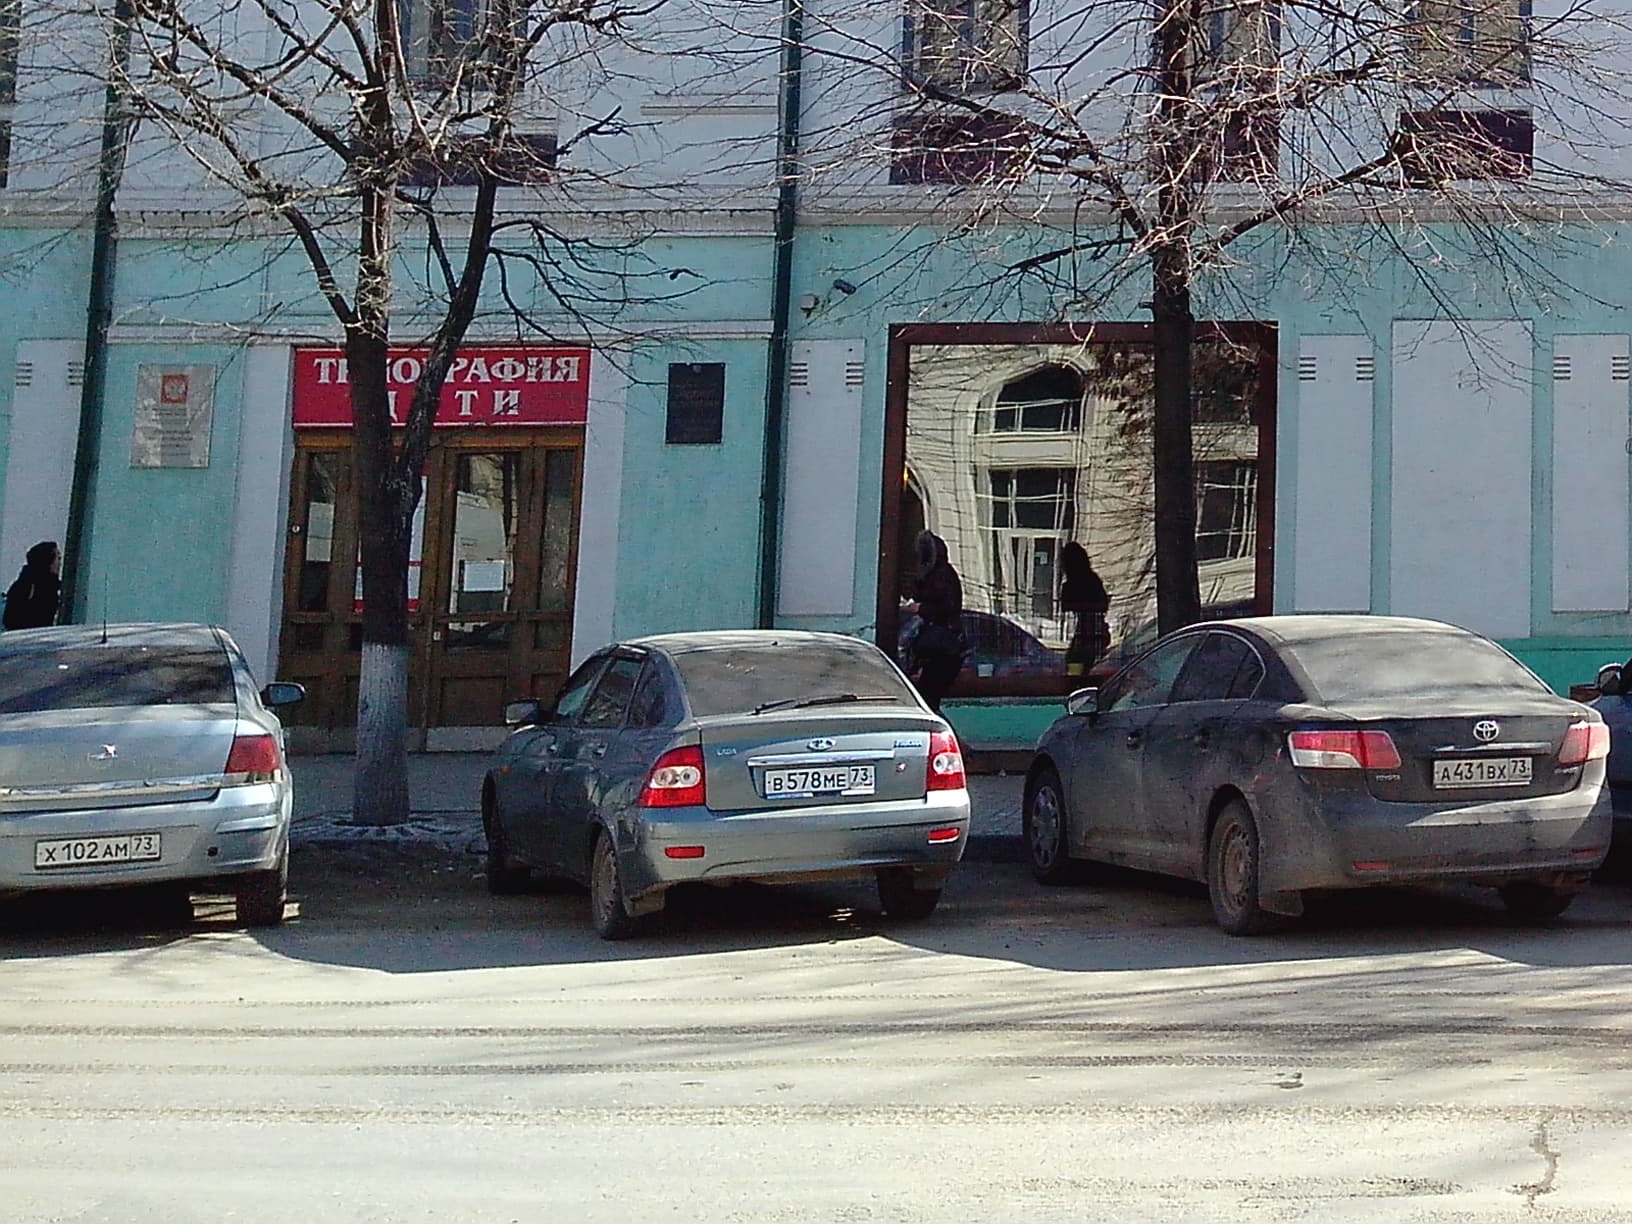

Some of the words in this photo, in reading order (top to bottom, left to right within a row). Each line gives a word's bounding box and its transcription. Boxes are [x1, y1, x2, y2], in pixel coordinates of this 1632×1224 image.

[1511, 760, 1526, 774] 73
[851, 768, 868, 782] 73
[134, 837, 153, 852] 73
